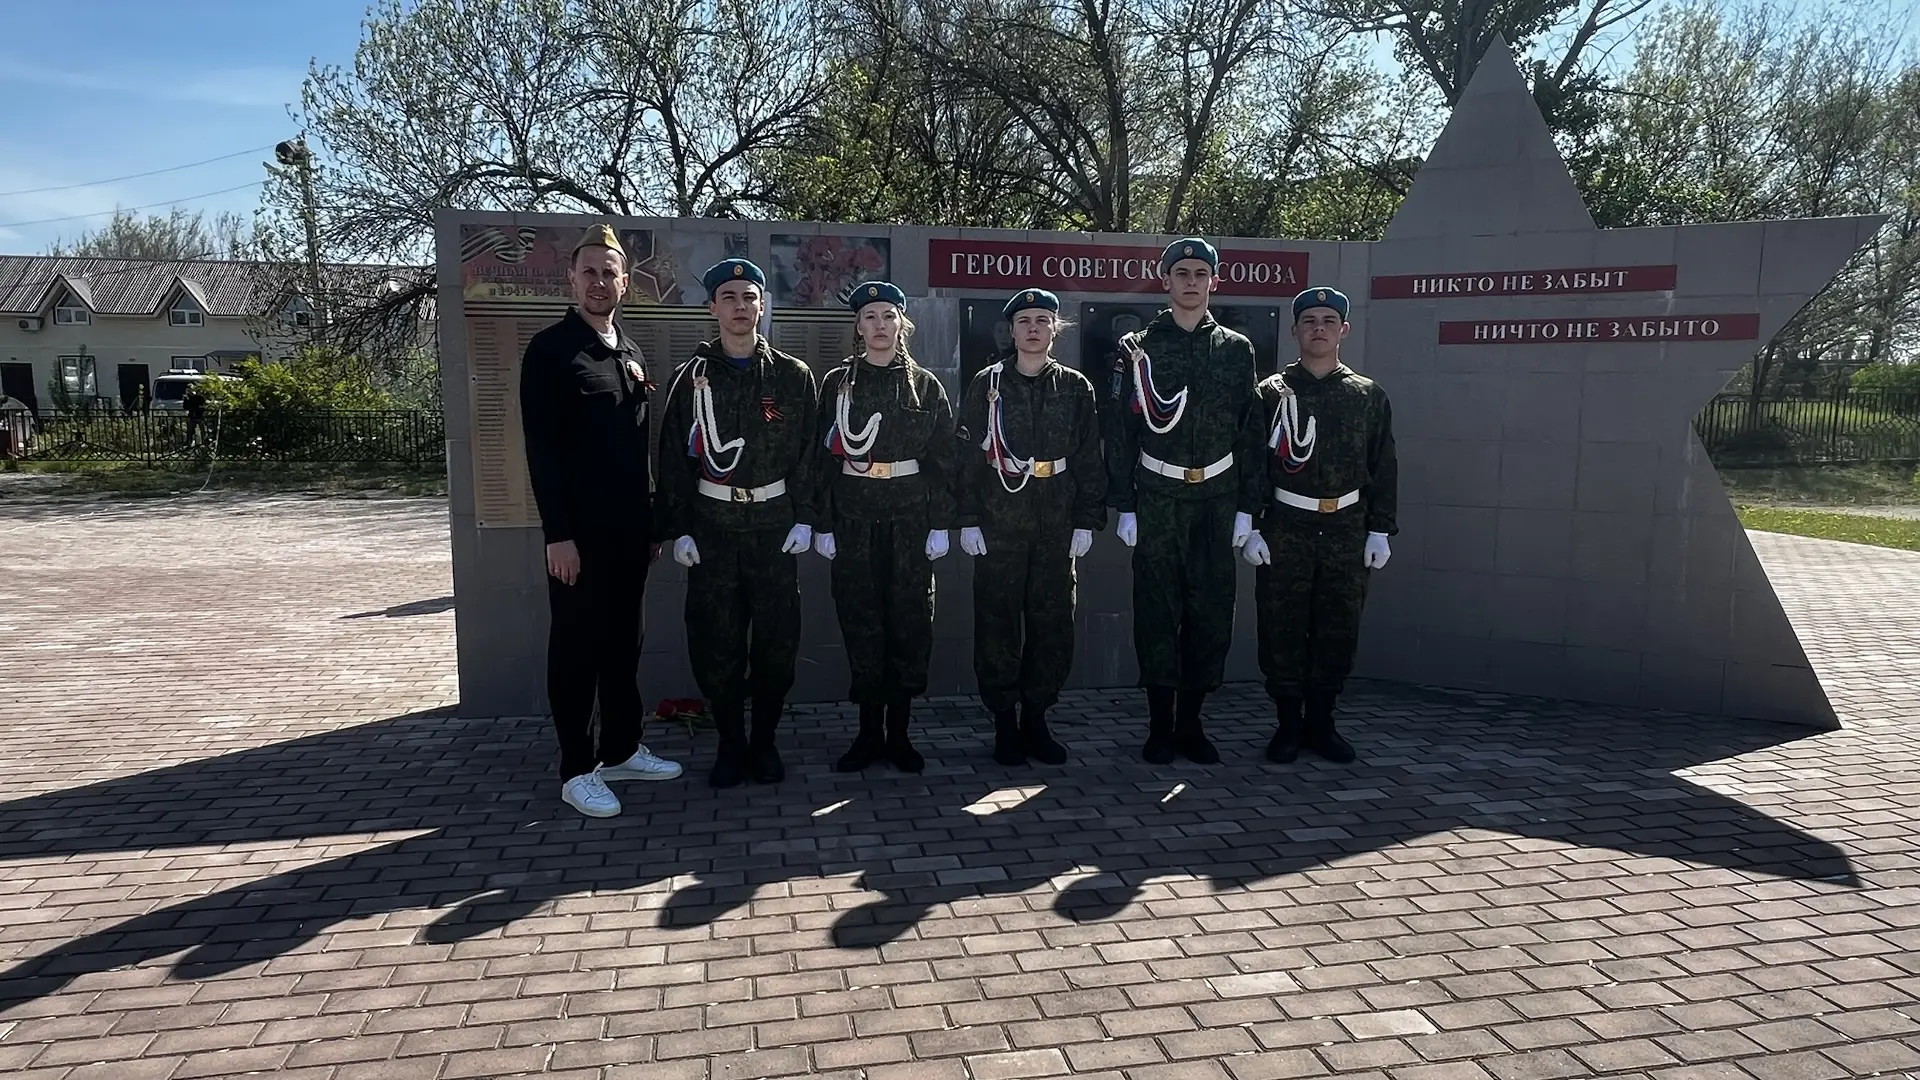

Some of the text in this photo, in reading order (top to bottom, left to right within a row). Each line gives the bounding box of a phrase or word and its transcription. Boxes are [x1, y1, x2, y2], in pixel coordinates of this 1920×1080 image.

[951, 253, 1031, 275] ГЕРОИ
[1218, 261, 1297, 283] СОЮЗА
[1412, 270, 1629, 295] НИКТО НЕ ЗАБЫТ
[1474, 319, 1721, 341] НИЧТО НЕ ЗАБЫТО
